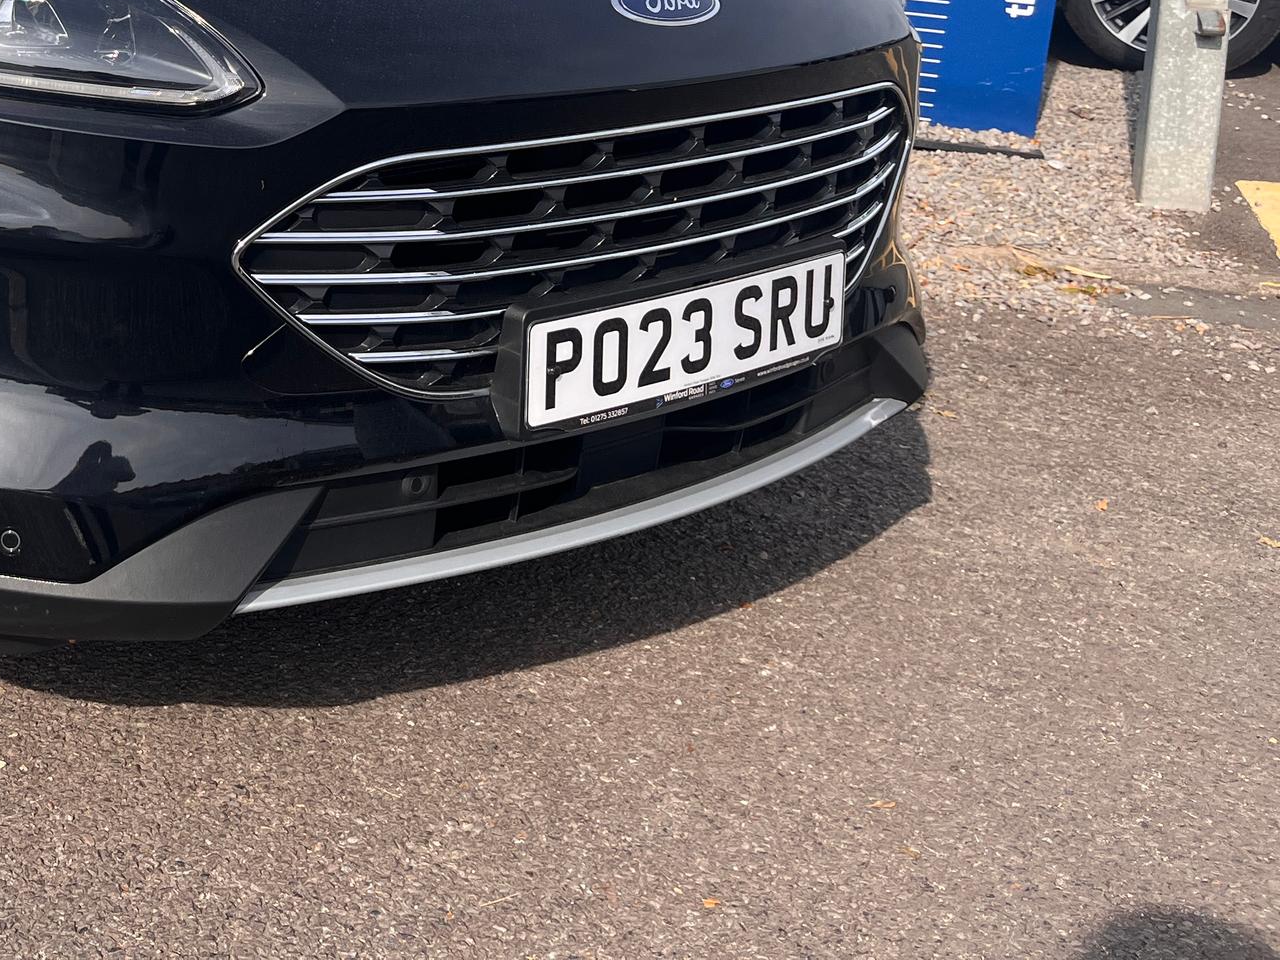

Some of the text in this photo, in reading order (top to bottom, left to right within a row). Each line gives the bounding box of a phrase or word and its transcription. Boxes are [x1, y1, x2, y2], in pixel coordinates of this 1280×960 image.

[545, 264, 834, 410] PO23 SRU
[688, 385, 705, 396] Road
